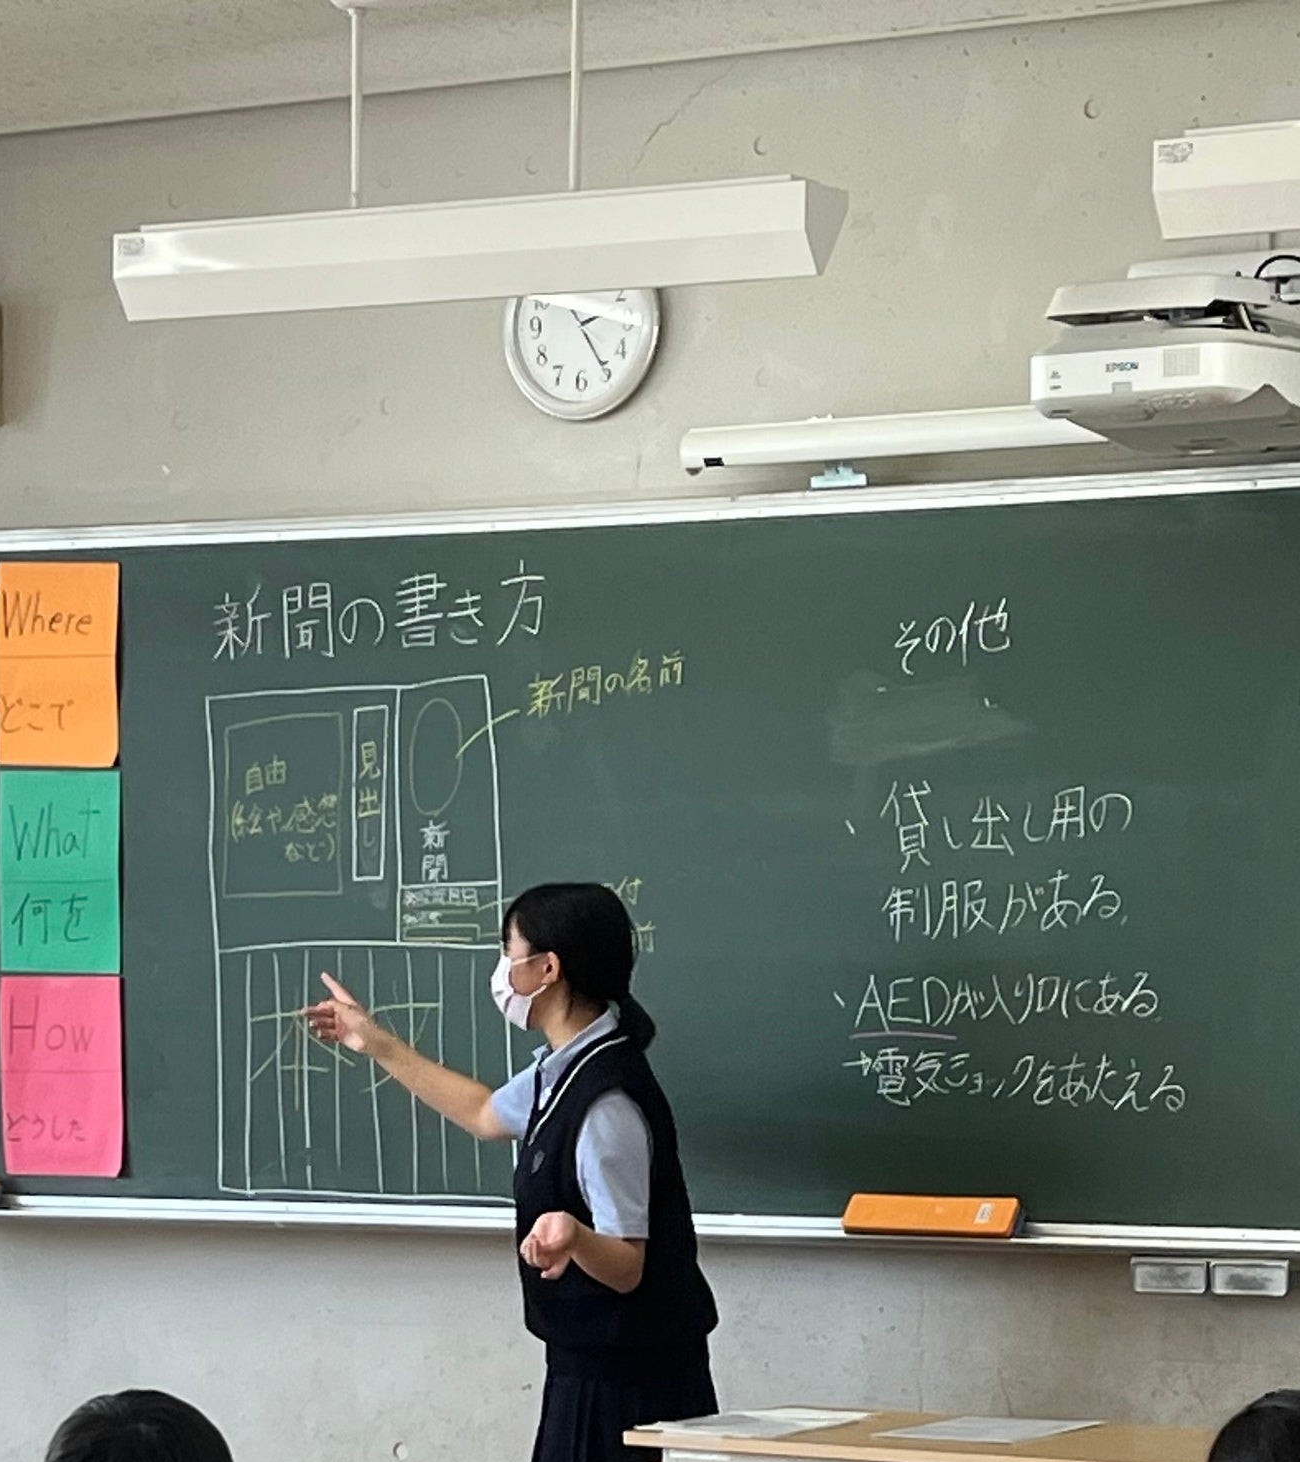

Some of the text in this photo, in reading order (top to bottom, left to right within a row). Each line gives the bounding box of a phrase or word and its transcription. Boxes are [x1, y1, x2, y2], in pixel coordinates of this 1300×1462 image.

[529, 315, 543, 339] 9
[614, 337, 626, 360] 4
[535, 345, 548, 366] 8
[552, 364, 564, 386] 7
[1105, 361, 1139, 373] EPSON
[575, 370, 588, 392] 6
[1, 590, 93, 638] Where
[213, 559, 546, 660] 新聞の書き方
[894, 596, 1011, 675] その他
[526, 650, 685, 719] 新聞の名前
[0, 695, 74, 733] どこで
[245, 754, 287, 795] 自由
[9, 799, 100, 862] What
[421, 819, 450, 882] 新聞
[880, 780, 1133, 874] 貸し出し用の
[11, 892, 90, 946] 何を
[9, 994, 94, 1055] How
